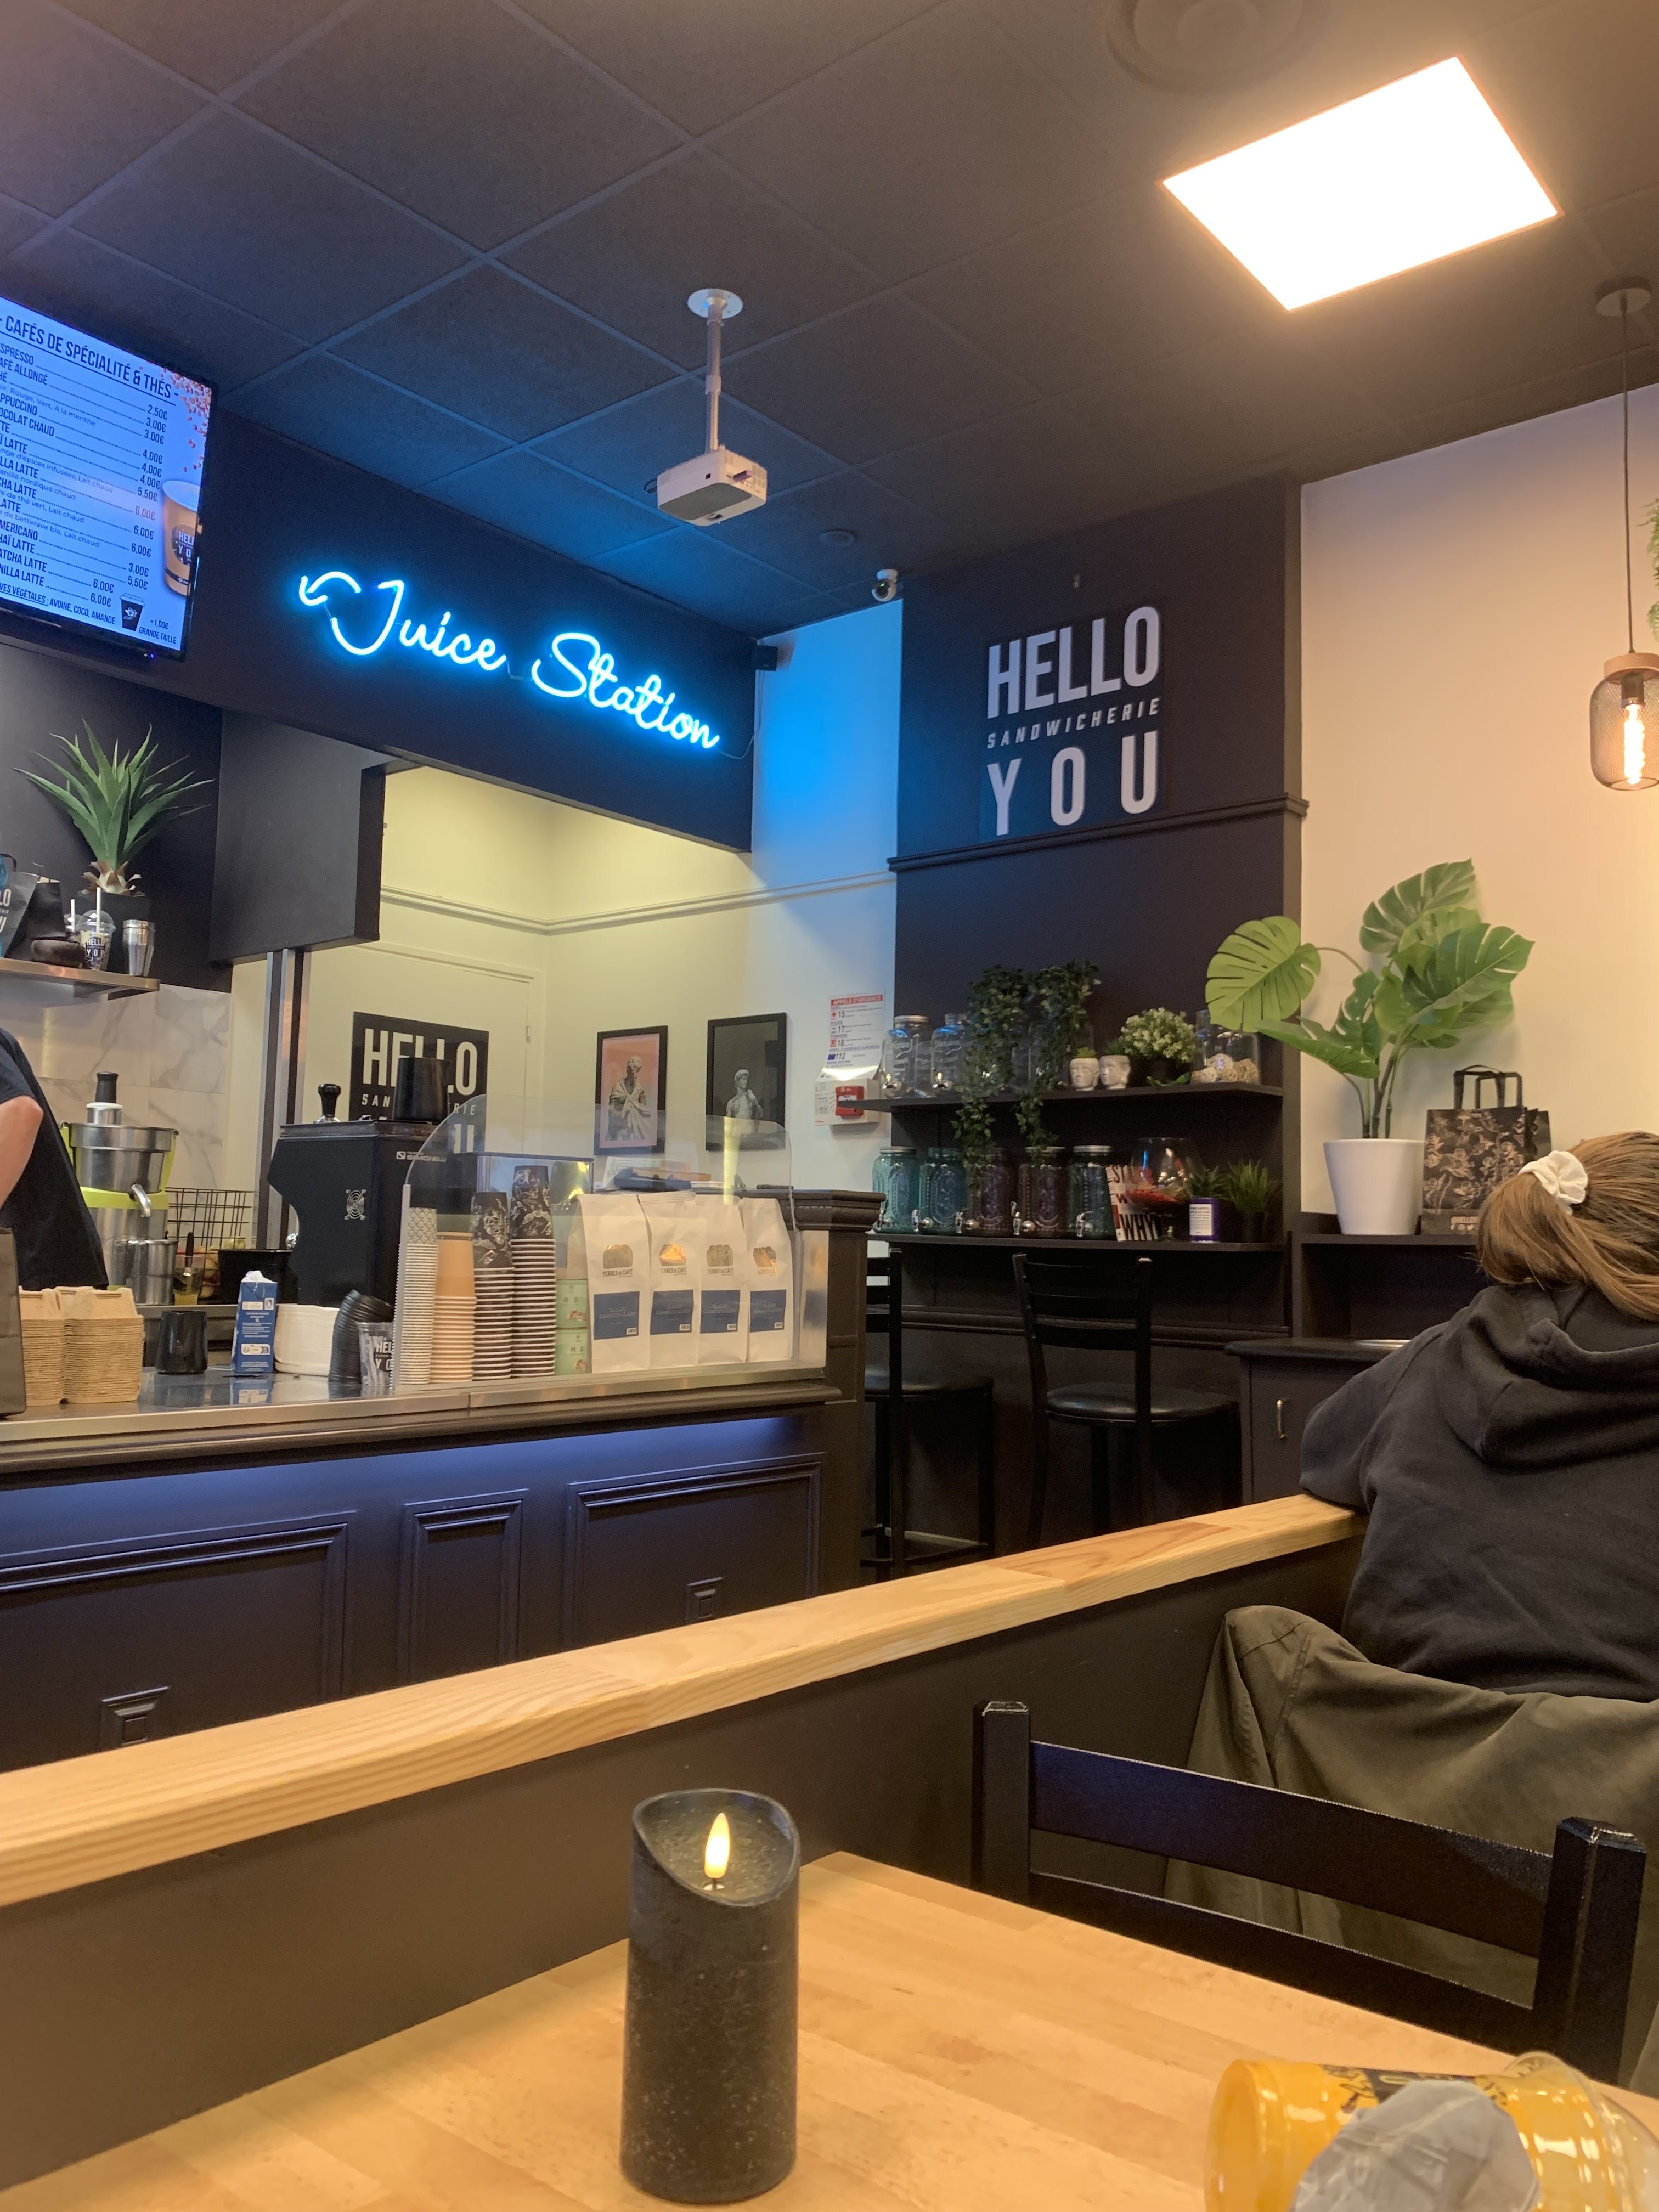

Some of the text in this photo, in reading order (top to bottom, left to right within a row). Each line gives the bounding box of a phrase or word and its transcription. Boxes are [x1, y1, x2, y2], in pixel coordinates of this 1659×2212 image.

[5, 315, 44, 345] CAFÉS
[47, 333, 63, 353] DE
[65, 341, 131, 381] SPÉCIALITÉ
[133, 370, 141, 386] &
[144, 374, 172, 398] THÉS
[14, 363, 48, 385] ALLONGÉ
[0, 343, 168, 420] SPRESSO 2,50€
[0, 392, 163, 465] PPUCCINO 4,00€
[69, 411, 96, 426] menthe
[29, 419, 54, 436] CHAUD
[142, 462, 162, 478] 4,00€
[4, 437, 28, 454] LATTE
[138, 487, 158, 502] 5,50€
[78, 475, 91, 485] Lait
[92, 481, 114, 493] chaud
[140, 475, 161, 489] 4,00€
[15, 461, 39, 479] LATTE
[135, 506, 155, 521] 6,00€
[54, 489, 76, 500] chaud
[14, 482, 37, 499] LATTE
[133, 524, 154, 540] 6,00€
[49, 506, 61, 516] Lait
[63, 512, 84, 523] chaud
[15, 514, 48, 530] betterave
[64, 531, 76, 540] Lait
[78, 535, 99, 548] chaud
[12, 537, 36, 554] LATTE
[127, 575, 148, 590] 5,50€
[131, 543, 152, 558] 6,00€
[24, 556, 47, 572] LATTE
[93, 578, 114, 594] 6,00€
[128, 562, 149, 577] 3,00€
[13, 585, 46, 603] VÉGÉTALES
[49, 598, 72, 613] AVOINE,
[73, 605, 90, 618] COCO,
[91, 611, 116, 625] AMANDE
[21, 571, 45, 587] LATTE
[90, 592, 111, 607] 6,00€
[139, 626, 177, 644] GRANDE TAILLE
[330, 579, 721, 750] Juice Station
[986, 606, 1160, 720] HELLO
[986, 696, 1161, 749] SANDWICHERIE
[87, 938, 105, 946] HELLO
[838, 1010, 845, 1018] 15
[838, 1025, 845, 1034] 17
[838, 1039, 844, 1047] 18
[363, 1028, 478, 1096] HEO
